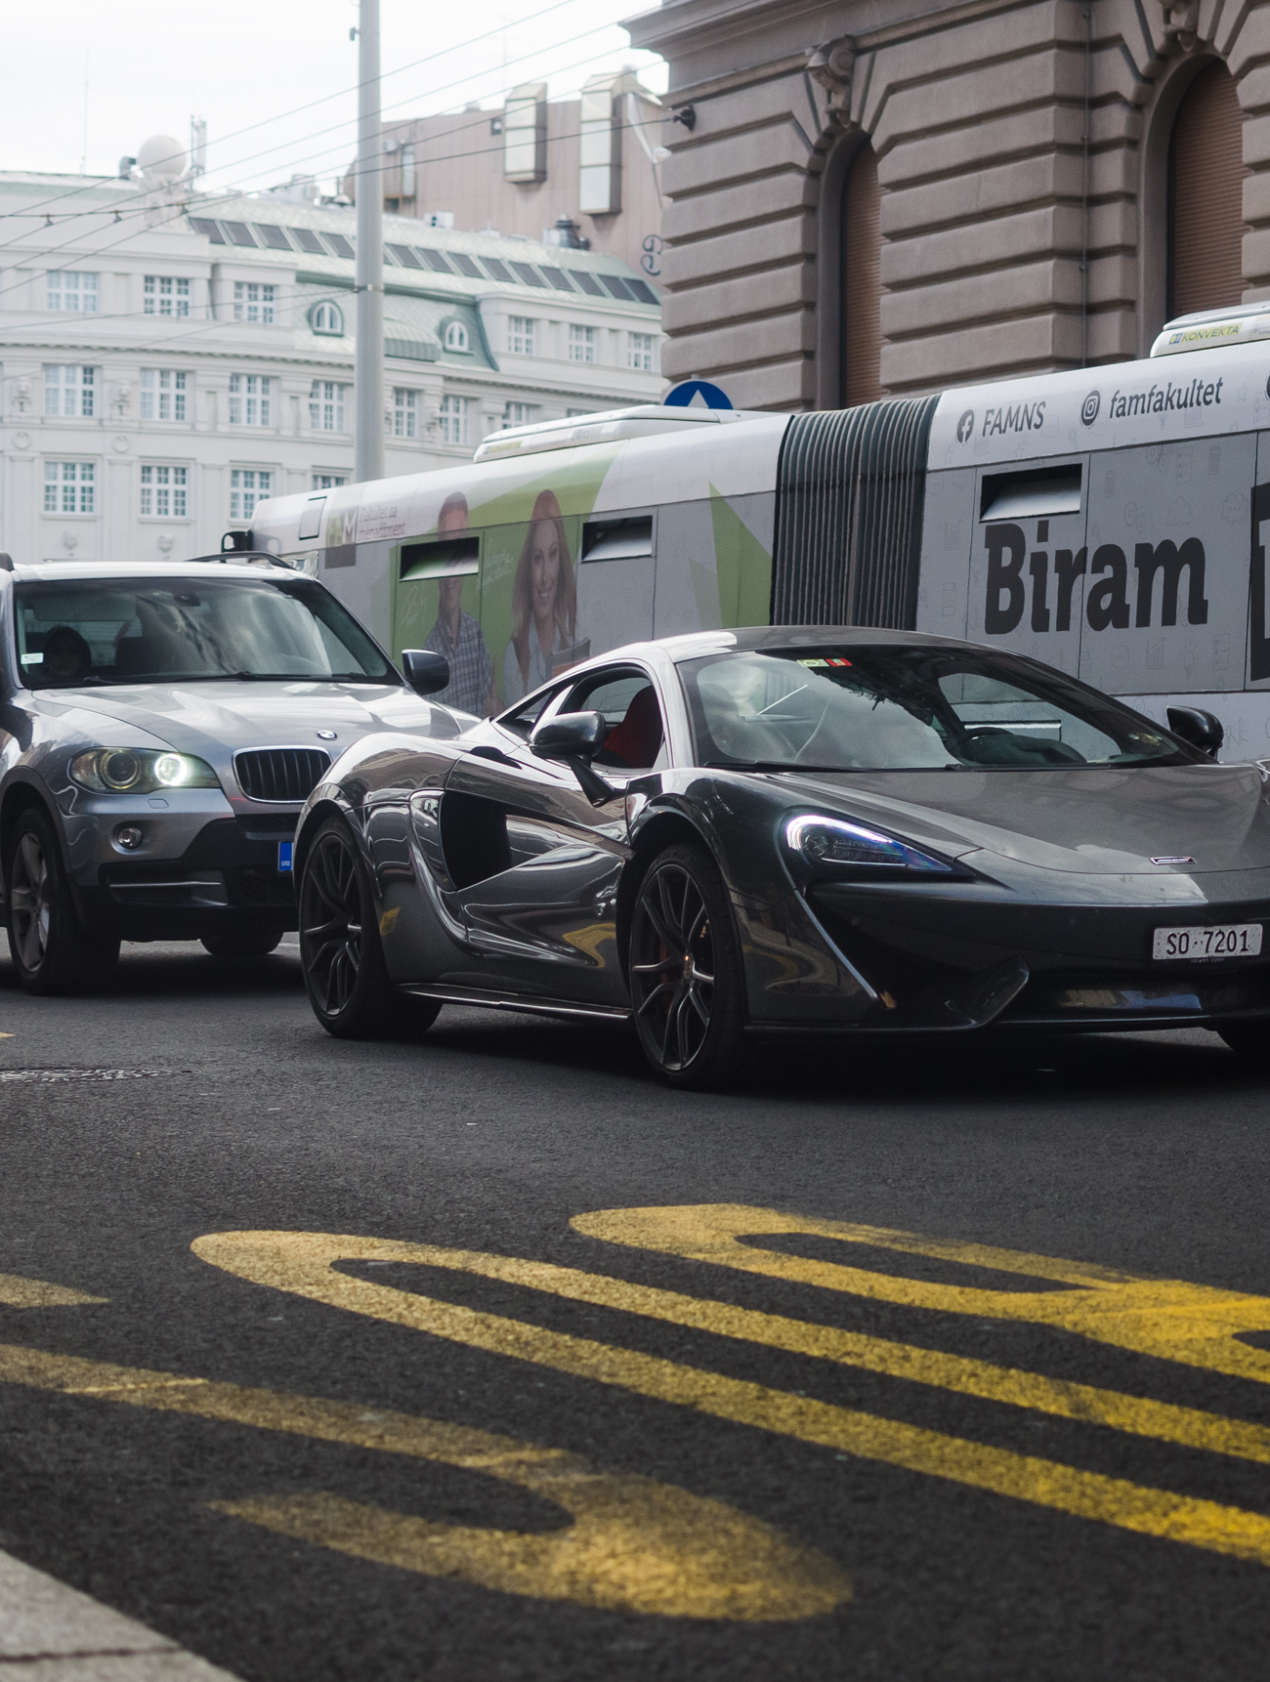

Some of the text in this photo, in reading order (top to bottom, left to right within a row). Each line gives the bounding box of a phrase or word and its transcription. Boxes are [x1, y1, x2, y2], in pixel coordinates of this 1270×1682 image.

[1181, 324, 1240, 343] KONVEKTA
[1108, 375, 1224, 419] famfakultet
[981, 400, 1047, 437] FAMNS
[983, 519, 1210, 635] Biram
